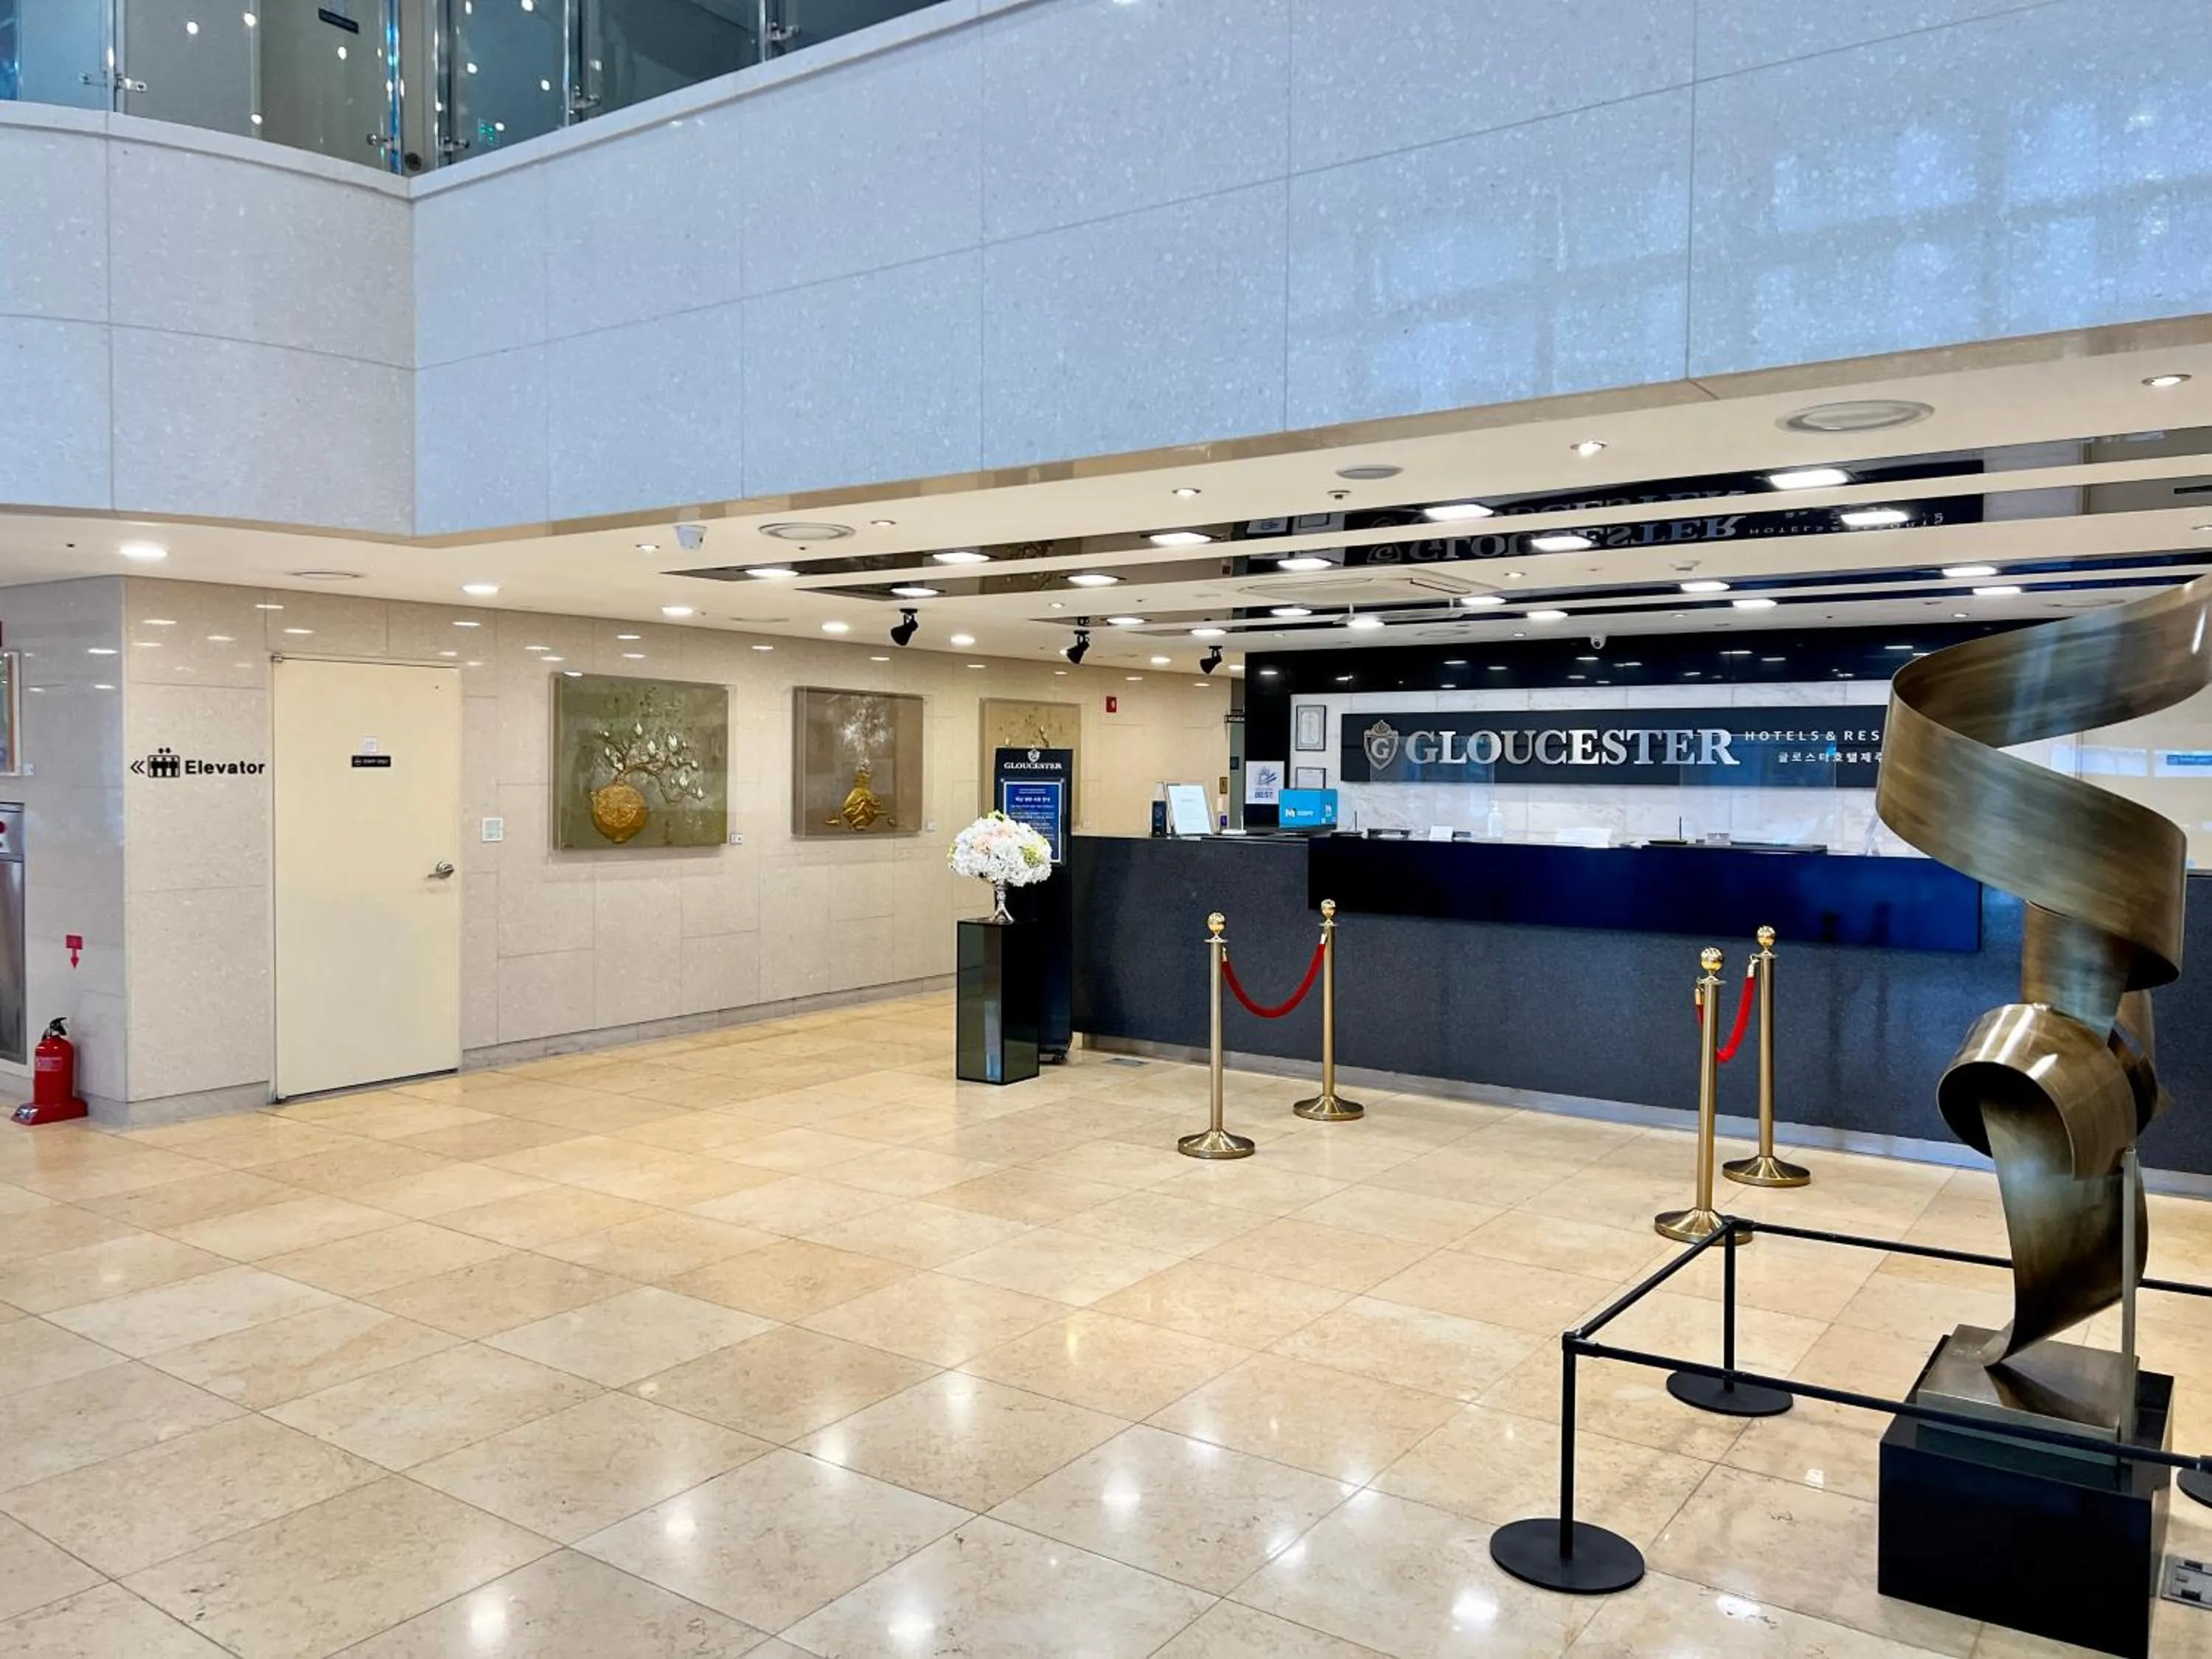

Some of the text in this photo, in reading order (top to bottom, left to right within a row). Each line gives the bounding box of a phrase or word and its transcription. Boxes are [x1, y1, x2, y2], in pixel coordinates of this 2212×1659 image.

[1405, 729, 1740, 765] GLOUCESTER
[1745, 731, 1819, 741] HOTELS
[185, 760, 265, 774] Elevator
